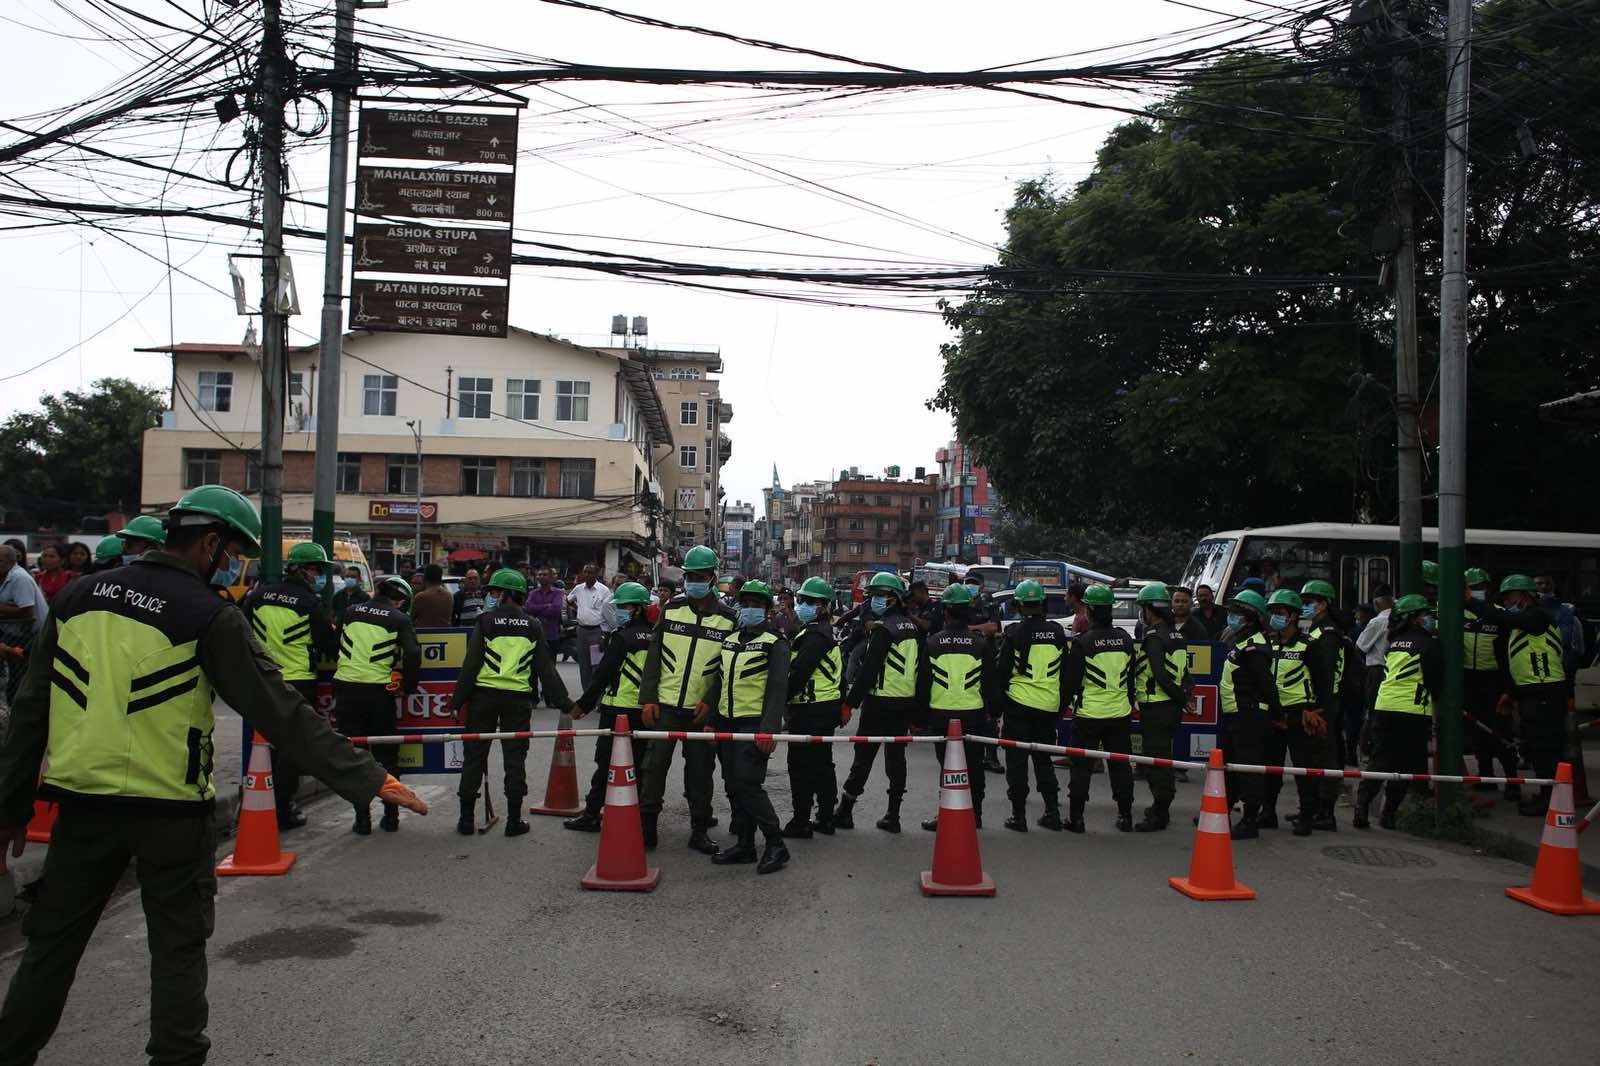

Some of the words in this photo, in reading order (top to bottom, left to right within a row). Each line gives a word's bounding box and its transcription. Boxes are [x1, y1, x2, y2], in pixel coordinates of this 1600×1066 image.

[387, 112, 442, 124] MANGAL
[446, 115, 489, 127] BAZAR
[479, 151, 495, 160] 700
[373, 169, 450, 182] MAHALAXMI
[453, 173, 497, 185] STHAN
[476, 209, 492, 217] 800
[387, 227, 433, 239] ASHOK
[435, 229, 478, 241] STUPA
[473, 266, 489, 275] 300
[375, 283, 417, 294] PATAN
[421, 285, 484, 297] HOSPITAL
[471, 323, 486, 331] 180
[92, 582, 122, 599] LMC
[124, 589, 167, 614] POLICE
[278, 593, 299, 605] POLICE
[369, 607, 391, 617] POLICE
[494, 617, 507, 626] LMC
[508, 618, 529, 627] POLICE
[669, 624, 686, 633] LMC
[705, 629, 723, 640] POLICE
[1035, 631, 1056, 640] POLICE
[939, 637, 951, 645] LMC
[953, 637, 973, 646] POLICE
[1094, 639, 1106, 647] LMC
[1106, 638, 1124, 647] POLICE
[944, 772, 968, 784] LMC
[1558, 815, 1577, 826] LM
